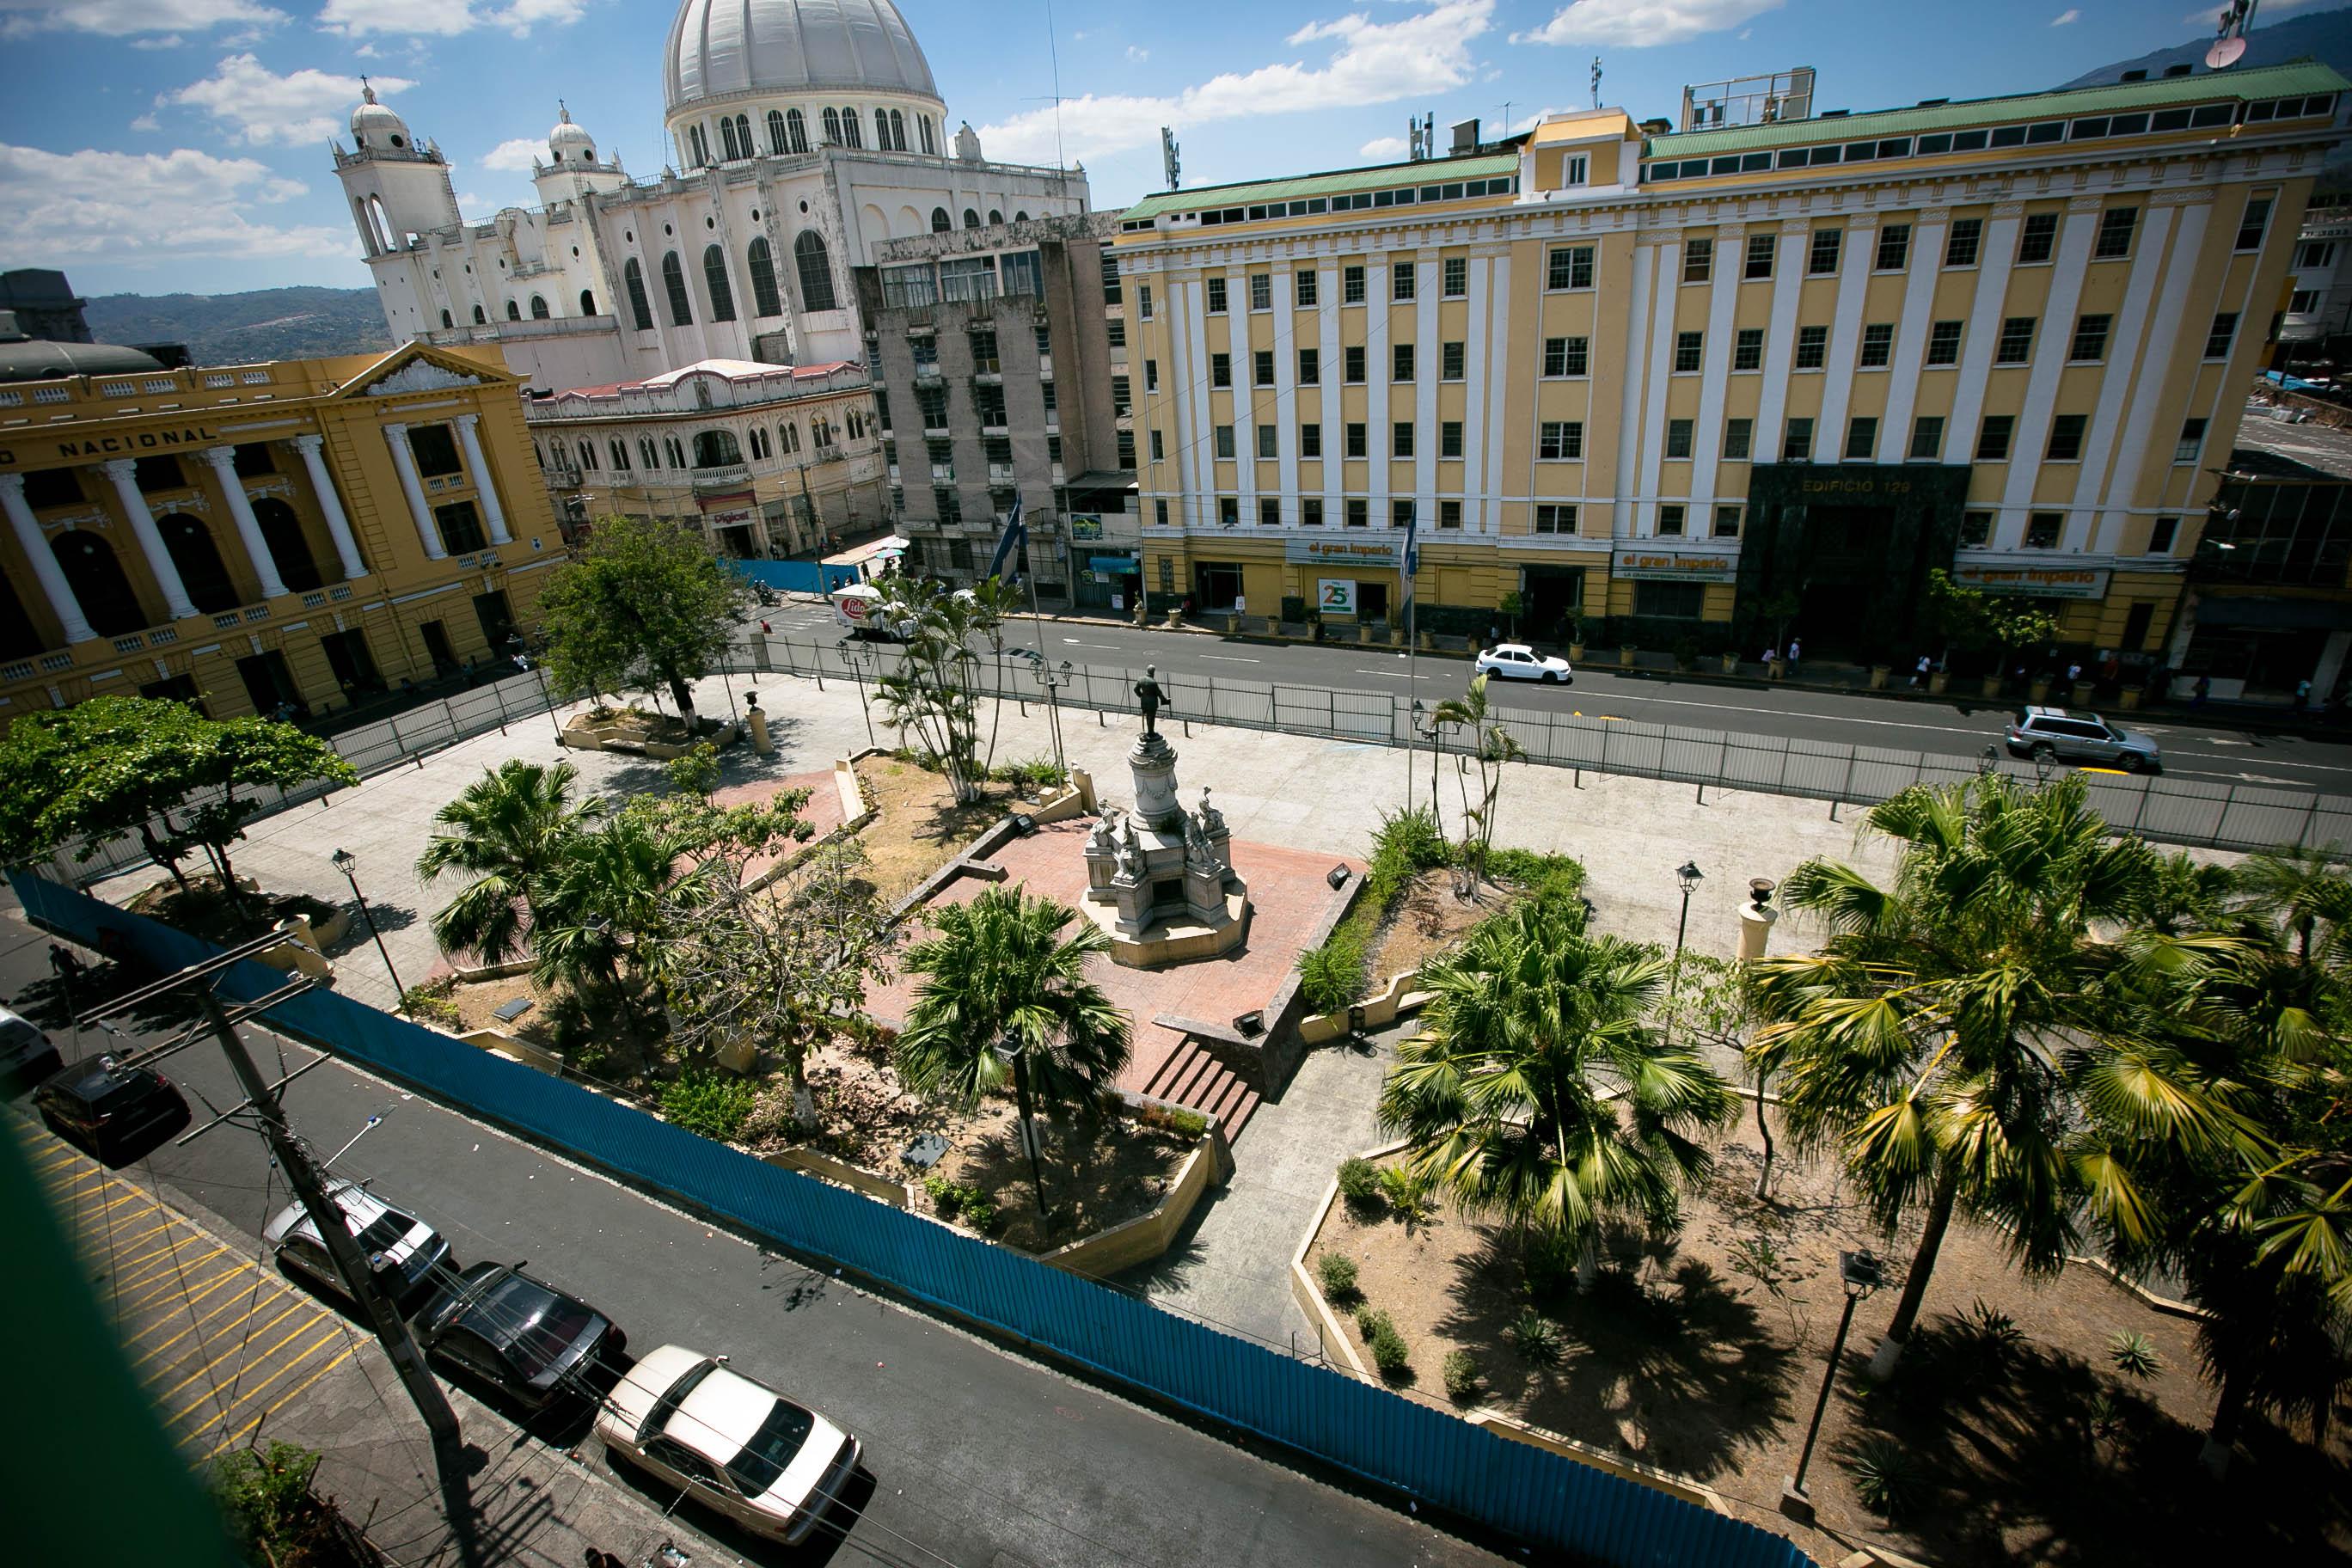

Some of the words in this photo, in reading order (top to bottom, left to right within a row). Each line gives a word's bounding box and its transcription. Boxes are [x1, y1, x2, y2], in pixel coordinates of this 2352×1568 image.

[58, 428, 217, 456] NACIONAL
[1802, 481, 1873, 493] EDIFICIO
[714, 511, 750, 524] Digicel
[1308, 542, 1320, 552] el
[1321, 542, 1347, 556] gran
[1623, 553, 1635, 565] el
[1639, 556, 1670, 568] gran
[844, 598, 866, 613] Lido
